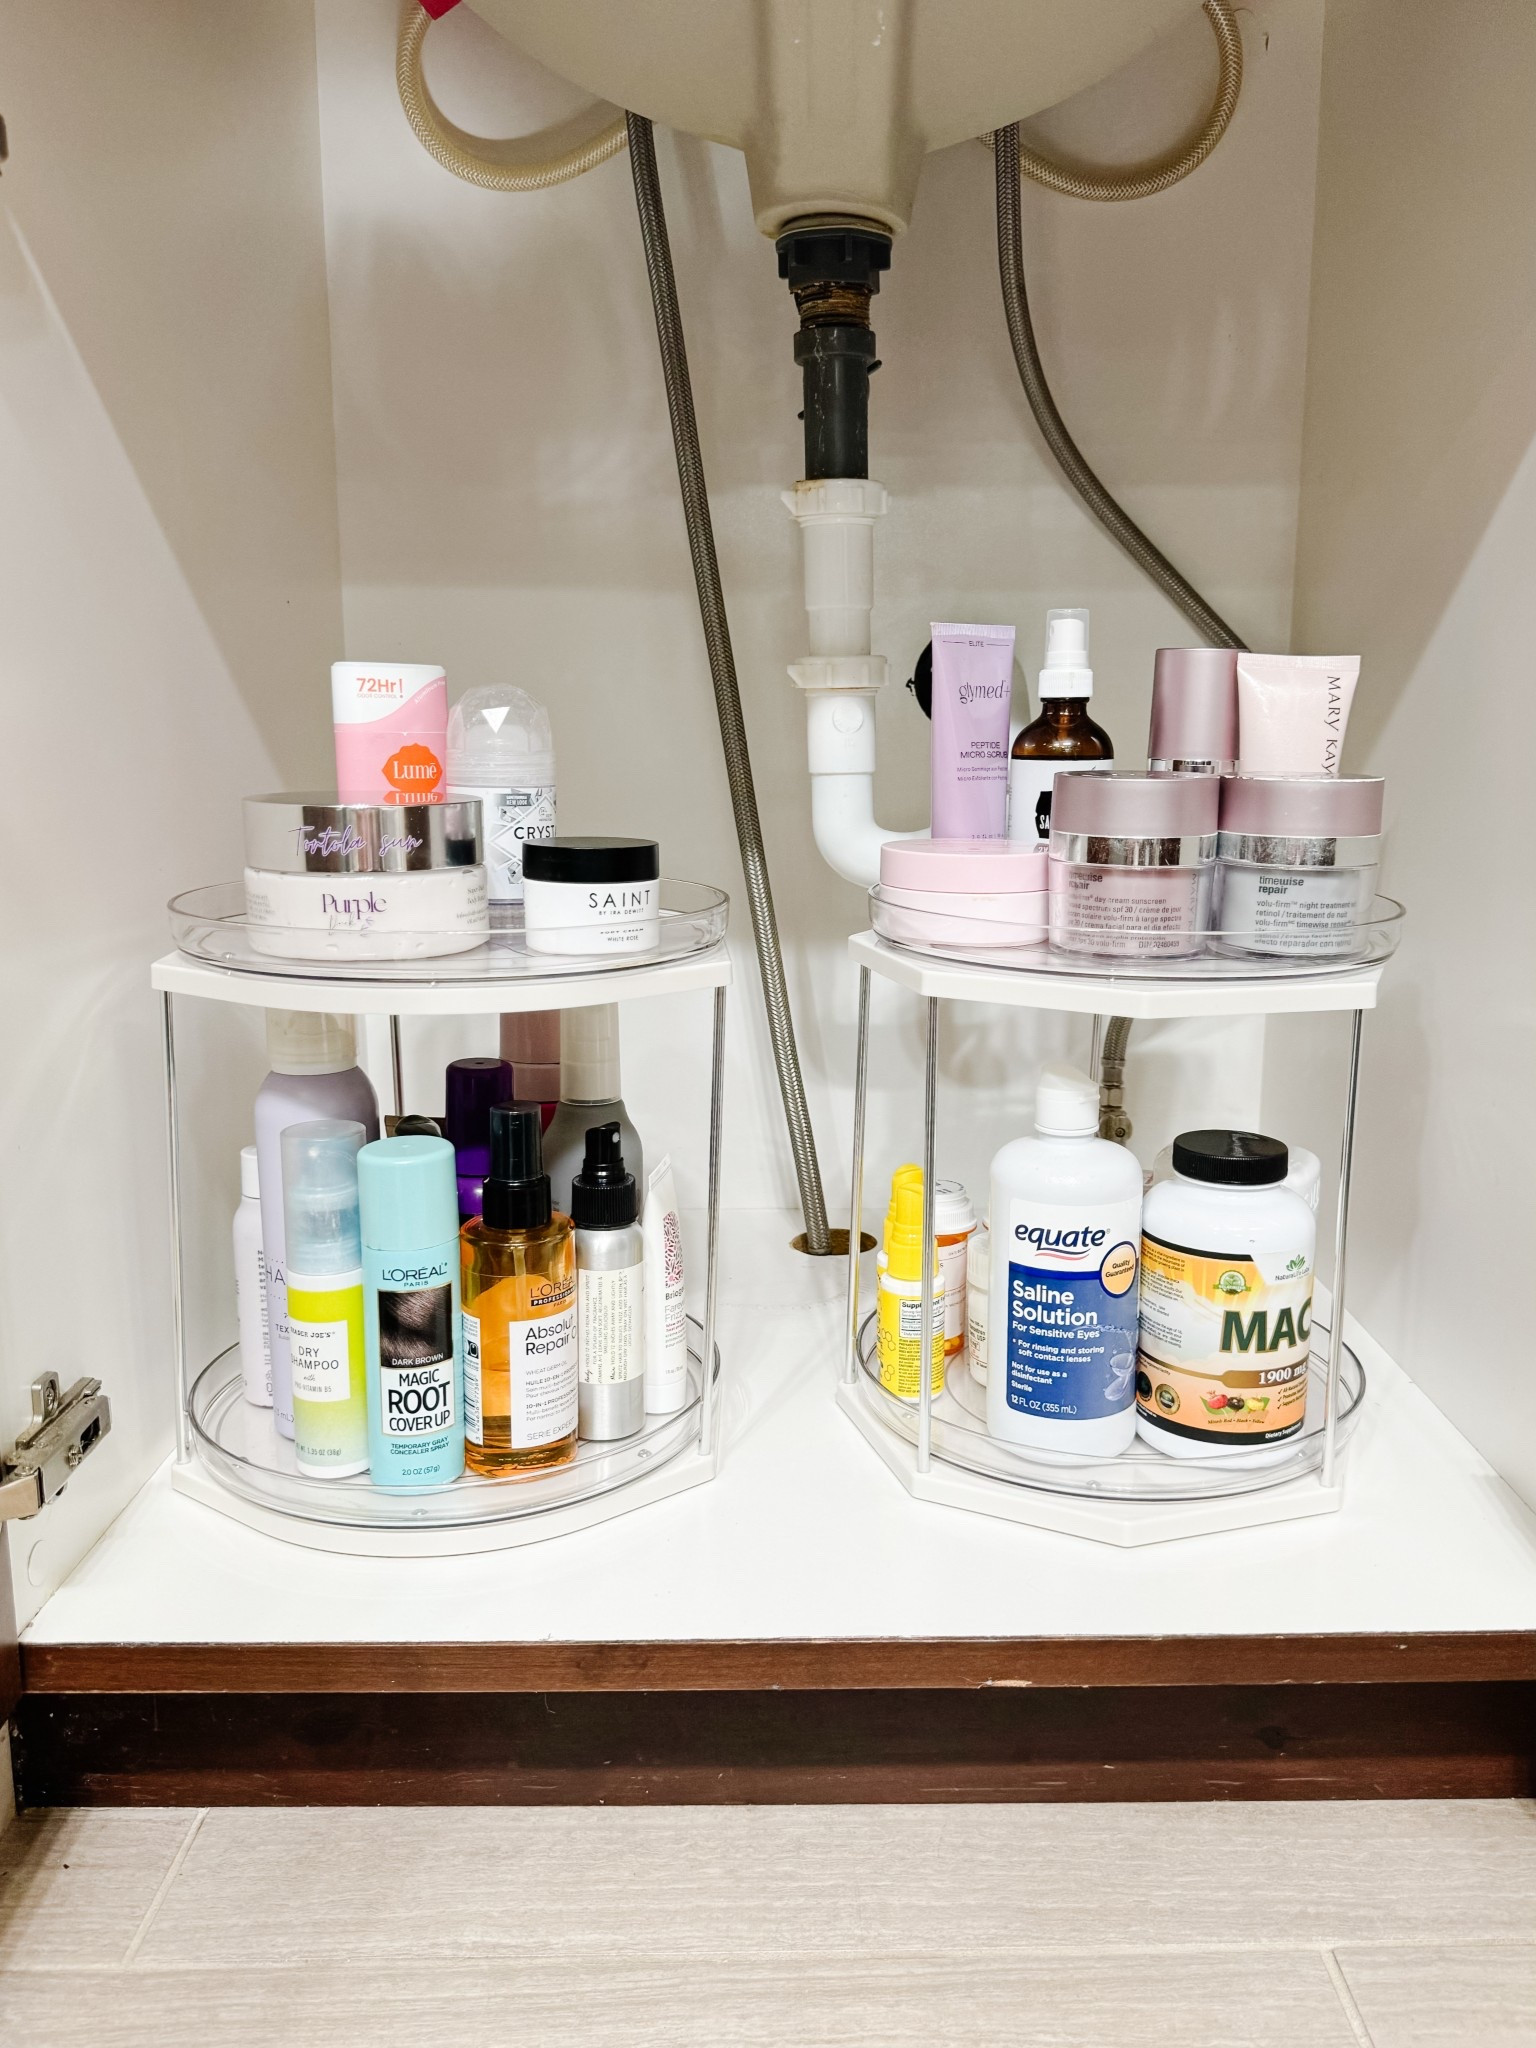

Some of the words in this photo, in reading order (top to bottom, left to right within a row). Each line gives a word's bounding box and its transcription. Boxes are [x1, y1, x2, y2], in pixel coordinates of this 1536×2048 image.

[1324, 675, 1342, 732] MARY
[970, 741, 1001, 750] PEPTIDE
[960, 750, 986, 759] MICRO
[986, 750, 1009, 760] SCRUB
[1321, 739, 1338, 776] KAY
[1259, 875, 1304, 887] timewise
[1258, 885, 1288, 896] repair
[322, 891, 388, 920] Purple
[589, 889, 651, 909] SAINT
[1299, 902, 1319, 911] night
[1014, 1223, 1106, 1252] equate
[1105, 1265, 1134, 1278] Guaranteed
[1111, 1259, 1131, 1270] Quality
[1012, 1279, 1075, 1305] Saline
[1012, 1299, 1098, 1326] Solution
[1012, 1320, 1028, 1332] For
[1029, 1325, 1075, 1339] Sensitive
[1077, 1329, 1100, 1340] Eyes
[298, 1345, 319, 1359] DRY
[525, 1332, 570, 1356] Repair
[1018, 1339, 1031, 1348] For
[1031, 1342, 1059, 1355] rinsing
[1060, 1345, 1076, 1354] and
[1077, 1345, 1105, 1356] storing
[391, 1357, 413, 1366] DARK
[415, 1352, 444, 1365] BROWN
[1018, 1348, 1033, 1358] soft
[1033, 1351, 1065, 1363] contact
[1066, 1354, 1092, 1363] lenses
[1011, 1360, 1024, 1370] Not
[1024, 1364, 1036, 1373] for
[1036, 1368, 1050, 1376] use
[1259, 1366, 1292, 1385] 1900
[399, 1368, 440, 1387] MAGIC
[1011, 1369, 1053, 1385] disinfectant
[1011, 1379, 1033, 1393] Sterile
[387, 1380, 451, 1415] ROOT
[1011, 1394, 1019, 1404] 12
[1018, 1397, 1028, 1408] FL
[1028, 1399, 1041, 1409] OZ
[1041, 1400, 1060, 1413] (355
[1060, 1403, 1078, 1415] mL)
[389, 1415, 433, 1432] COVER
[434, 1409, 451, 1427] UP
[390, 1447, 430, 1455] CONCEALER
[430, 1441, 450, 1452] SPRAY
[391, 1441, 431, 1449] TEMPORARY
[431, 1435, 449, 1446] GRAY
[412, 1467, 423, 1475] OZ
[423, 1463, 441, 1475] (57g)
